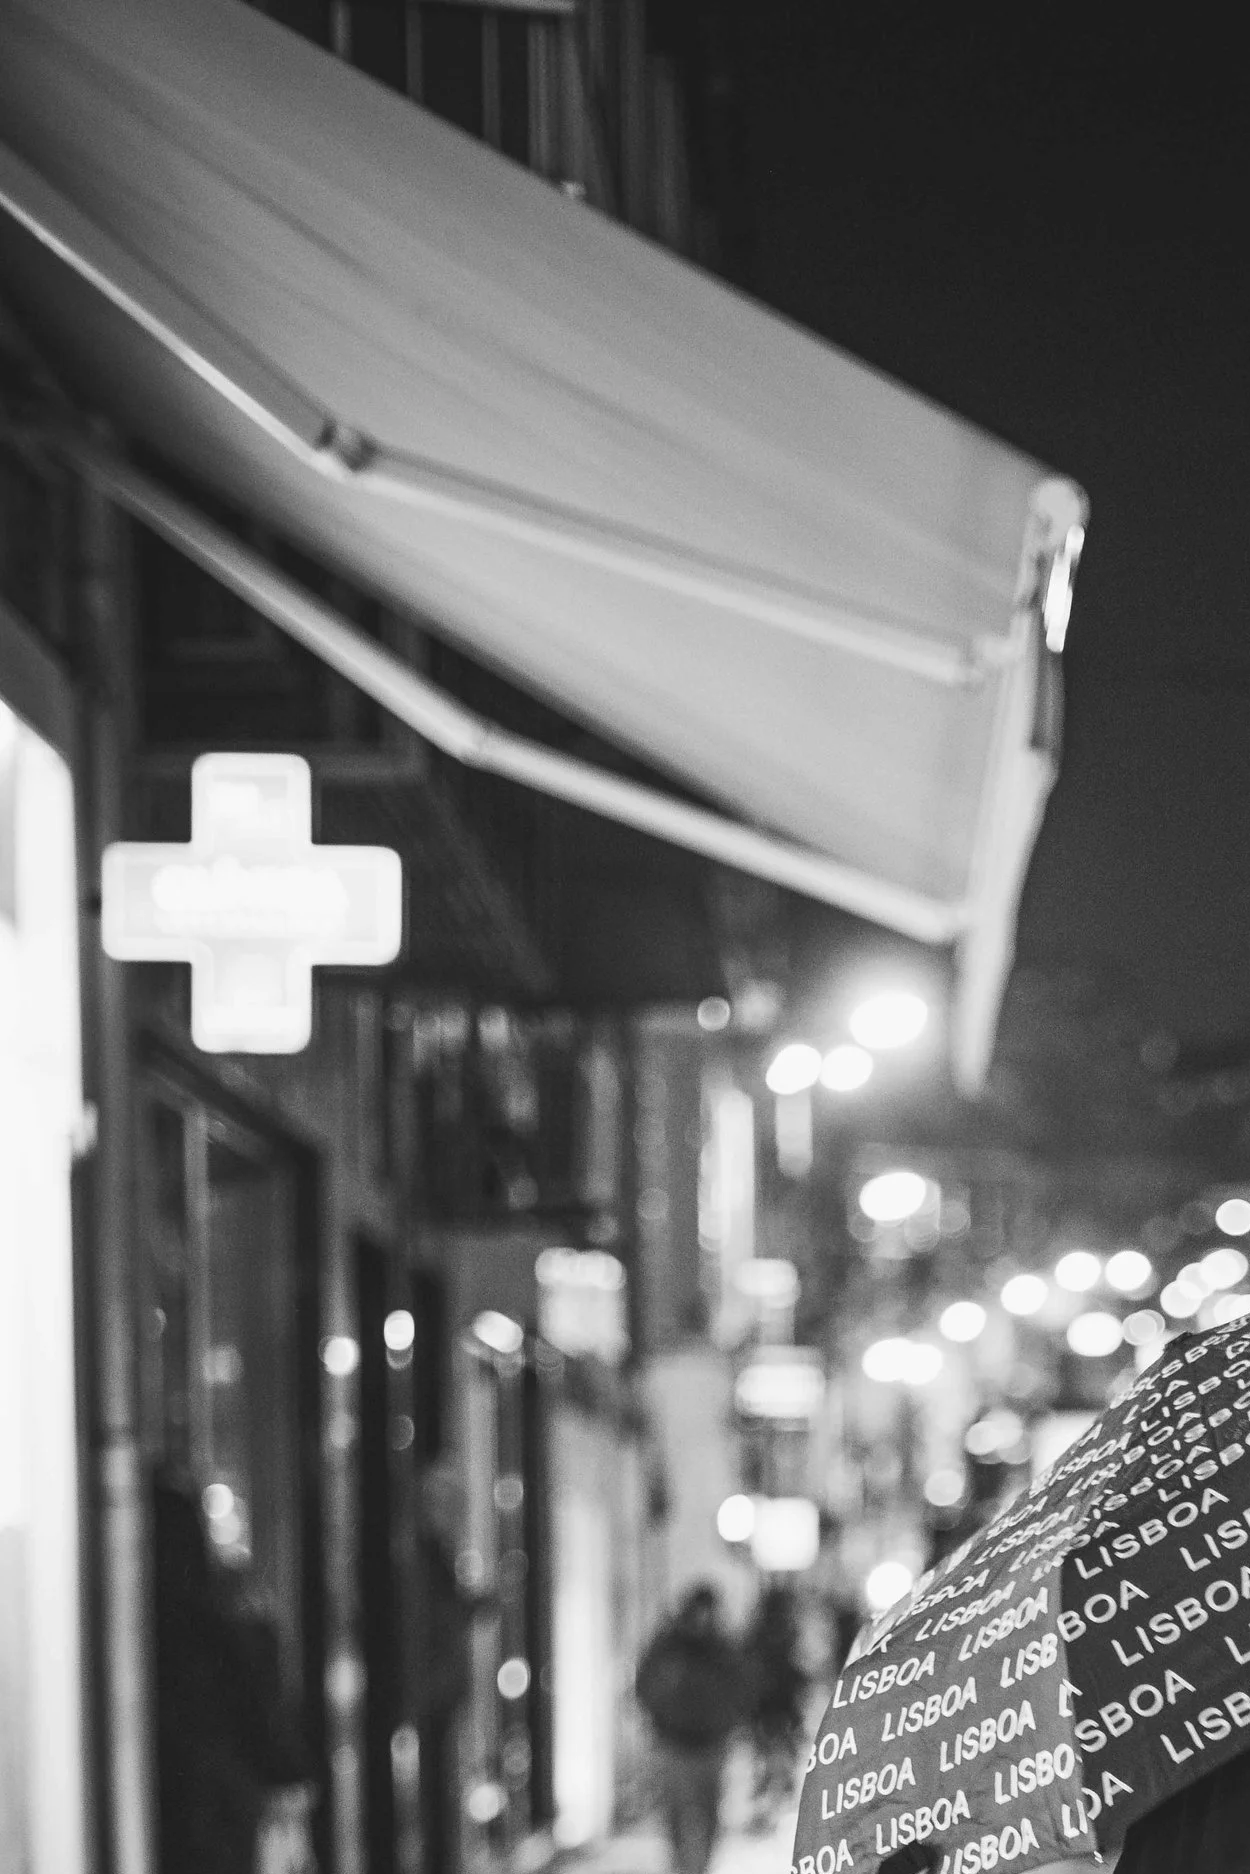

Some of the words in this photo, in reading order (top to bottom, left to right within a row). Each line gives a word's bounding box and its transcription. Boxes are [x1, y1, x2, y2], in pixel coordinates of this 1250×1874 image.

[1074, 1487, 1230, 1580] LISBOA
[833, 1650, 936, 1709] LISBOA
[880, 1676, 978, 1742] LISBOA
[940, 1699, 1037, 1773] LISBOA
[821, 1756, 917, 1821] LISBOA
[875, 1789, 972, 1855] LISBOA
